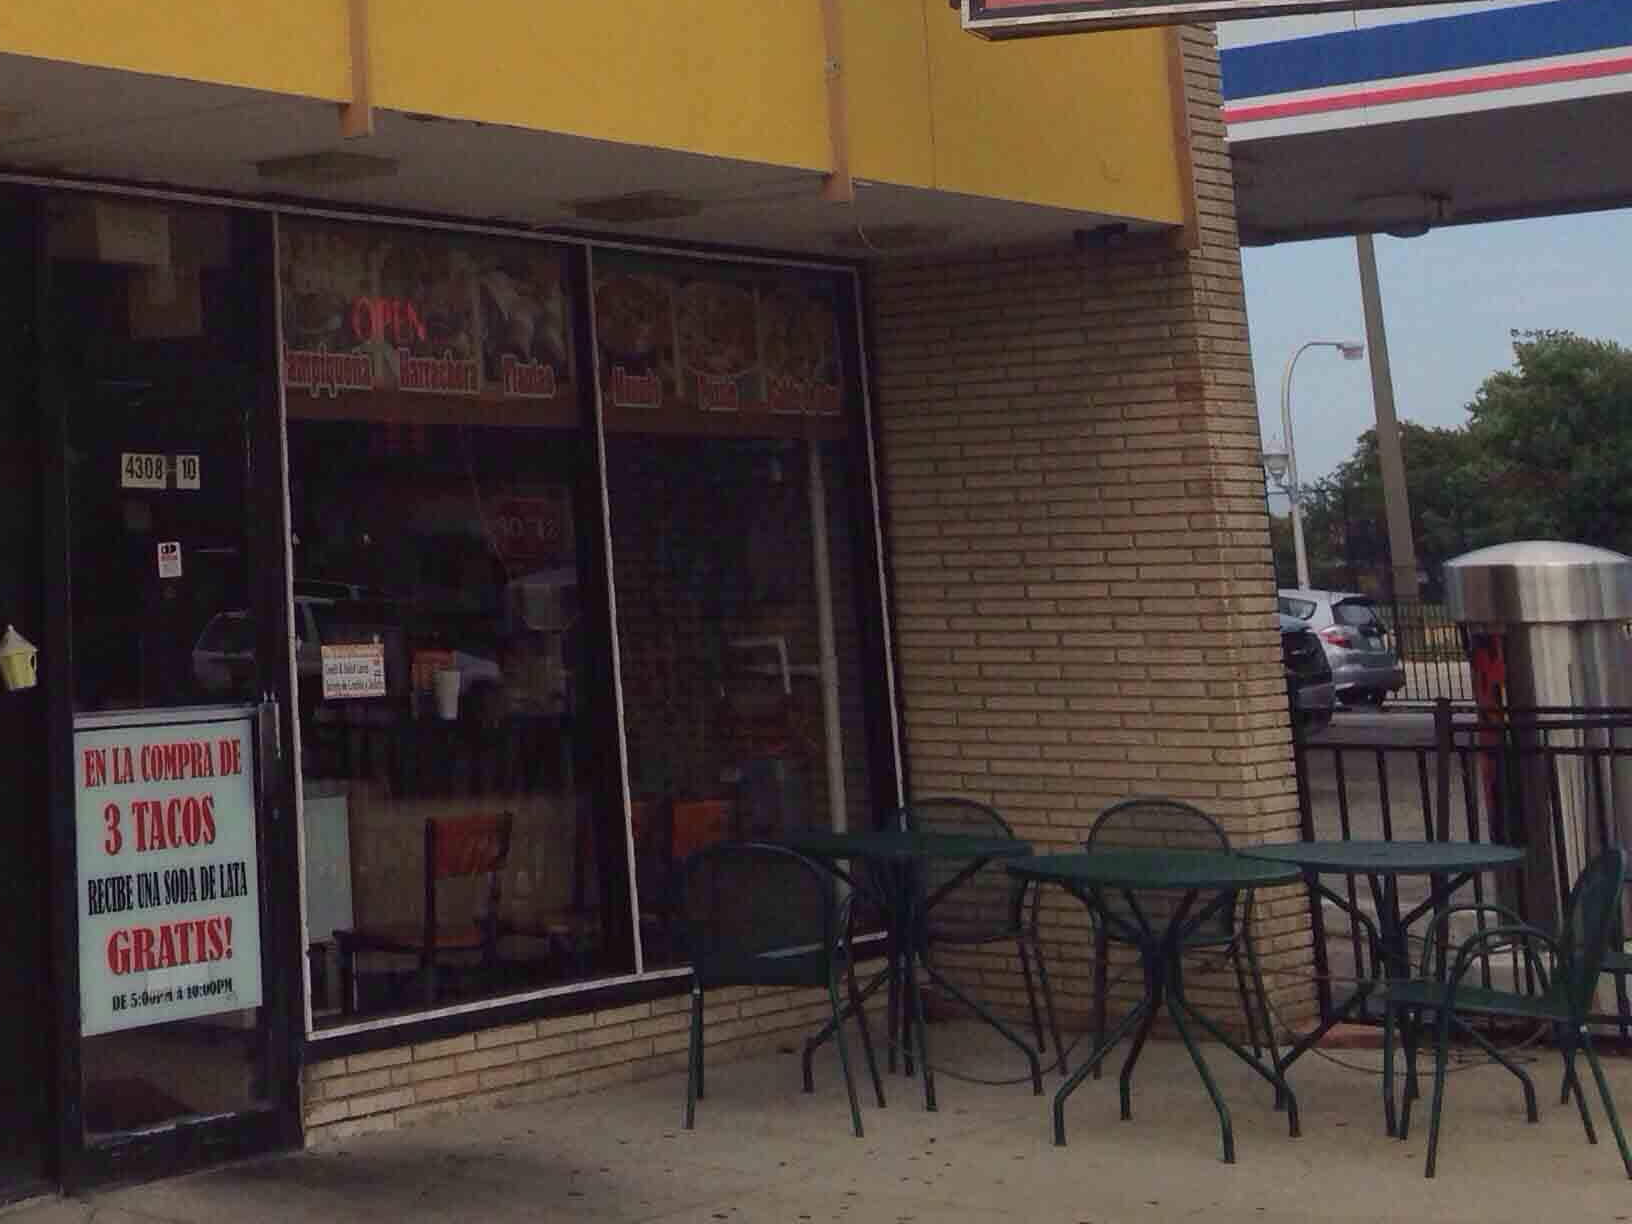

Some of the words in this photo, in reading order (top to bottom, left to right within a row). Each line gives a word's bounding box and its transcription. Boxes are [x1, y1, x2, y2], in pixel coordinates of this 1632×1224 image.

[352, 296, 428, 343] OPEN
[125, 456, 163, 480] 4308
[84, 748, 106, 787] EN
[113, 746, 134, 784] LA
[141, 739, 214, 783] COMPRA
[220, 739, 241, 776] DE
[104, 801, 122, 856] 3
[131, 795, 216, 853] TACOS
[88, 874, 133, 916] RECIBE
[137, 871, 161, 909] UNA
[165, 866, 196, 906] SODA
[200, 864, 216, 901] DE
[220, 861, 248, 898] LATA
[107, 917, 233, 976] GRATIS!
[112, 994, 127, 1011] DE
